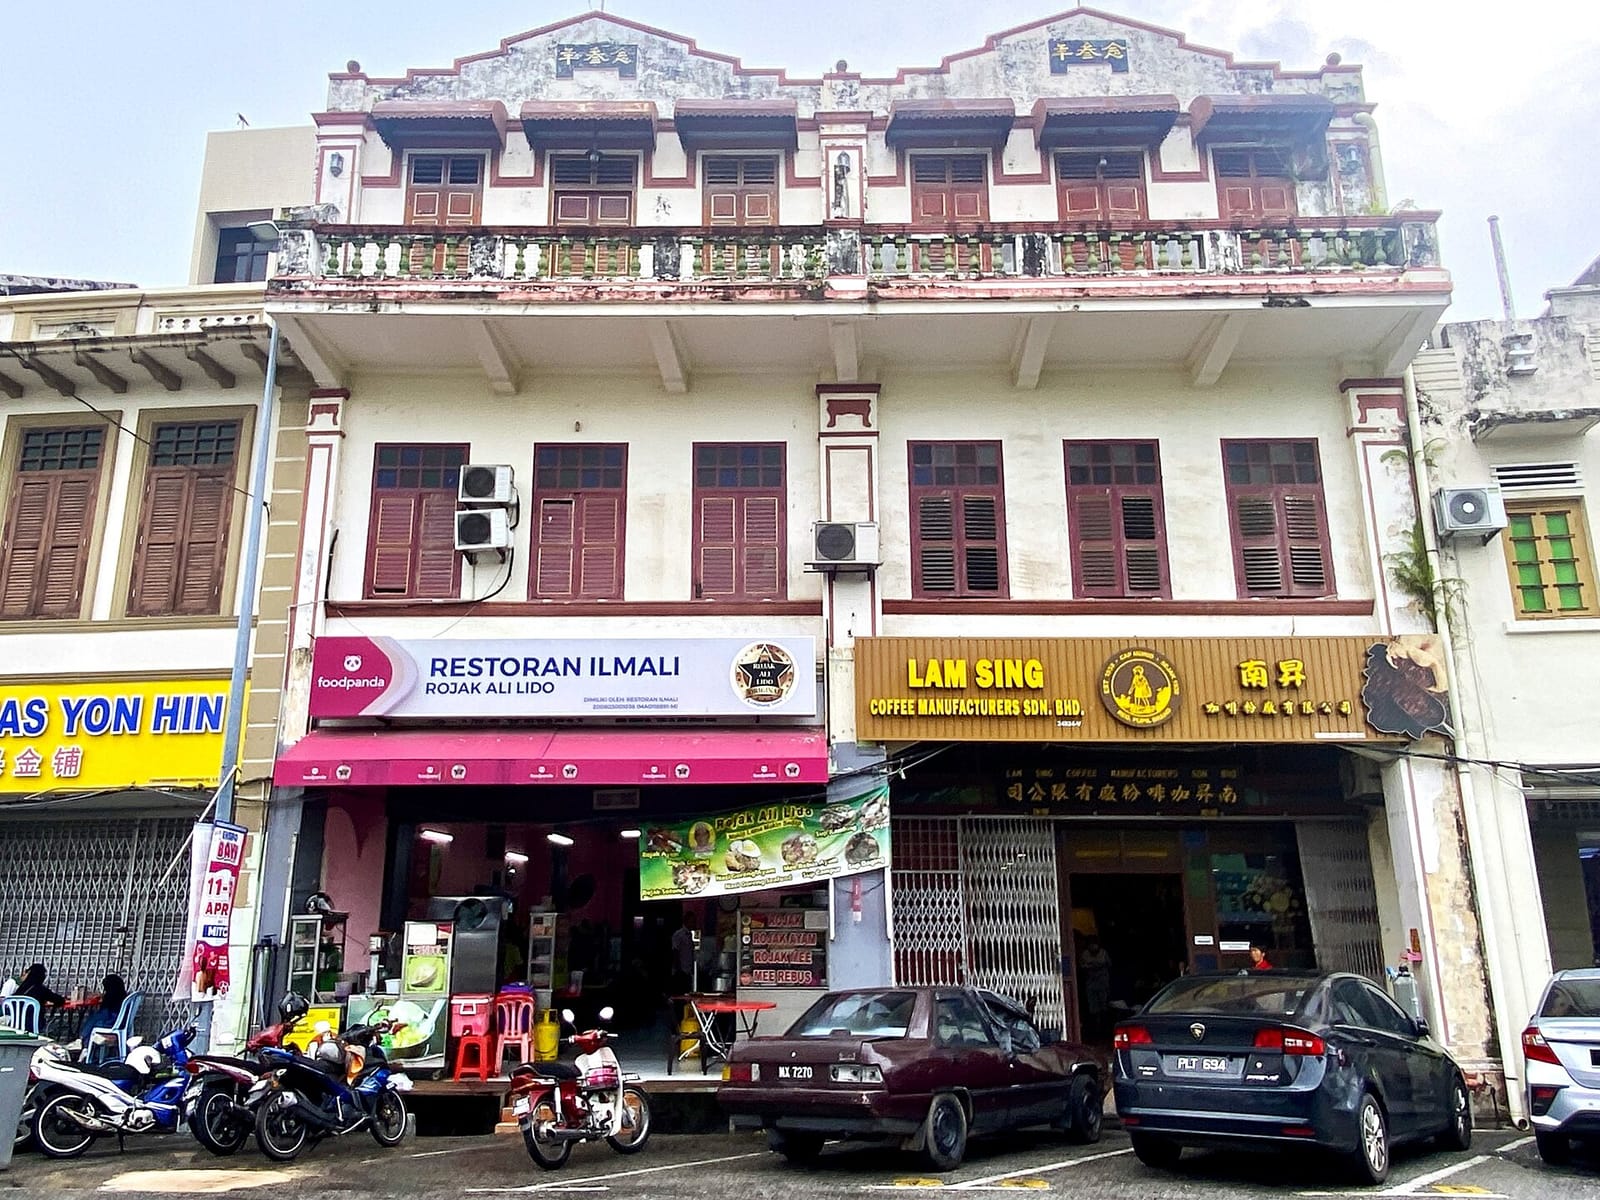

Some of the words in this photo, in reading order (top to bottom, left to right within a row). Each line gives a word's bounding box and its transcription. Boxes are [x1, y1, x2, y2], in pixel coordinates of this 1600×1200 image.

[430, 656, 581, 677] RESTORAN
[590, 655, 680, 676] ILMALI
[907, 658, 967, 689] LAM
[975, 658, 1044, 689] SING
[1238, 658, 1306, 689] 南昇
[758, 670, 771, 678] ALI
[317, 675, 385, 690] foodpanda
[425, 681, 482, 695] ROJAK
[486, 681, 512, 695] ALI
[516, 681, 555, 694] LIDO
[756, 678, 774, 686] LIDO
[61, 696, 141, 734] YON
[152, 695, 224, 732] HIN
[870, 698, 915, 716] COFFEE
[917, 698, 1020, 716] MANUFACTURERS
[1023, 699, 1053, 716] SDN.
[1055, 699, 1085, 716] BHD.
[0, 748, 82, 777] 金铺
[715, 811, 754, 830] Rojak
[782, 805, 814, 820] Lido
[767, 912, 802, 928] ROJAK
[752, 932, 788, 945] ROJAK
[789, 932, 817, 946] AYAM
[753, 949, 788, 964] ROJAK
[789, 951, 813, 964] MEE
[753, 969, 776, 983] MEE
[777, 970, 812, 984] REBUS
[1177, 1057, 1199, 1070] PLT
[1202, 1058, 1227, 1071] 694
[792, 1065, 814, 1079] 7270
